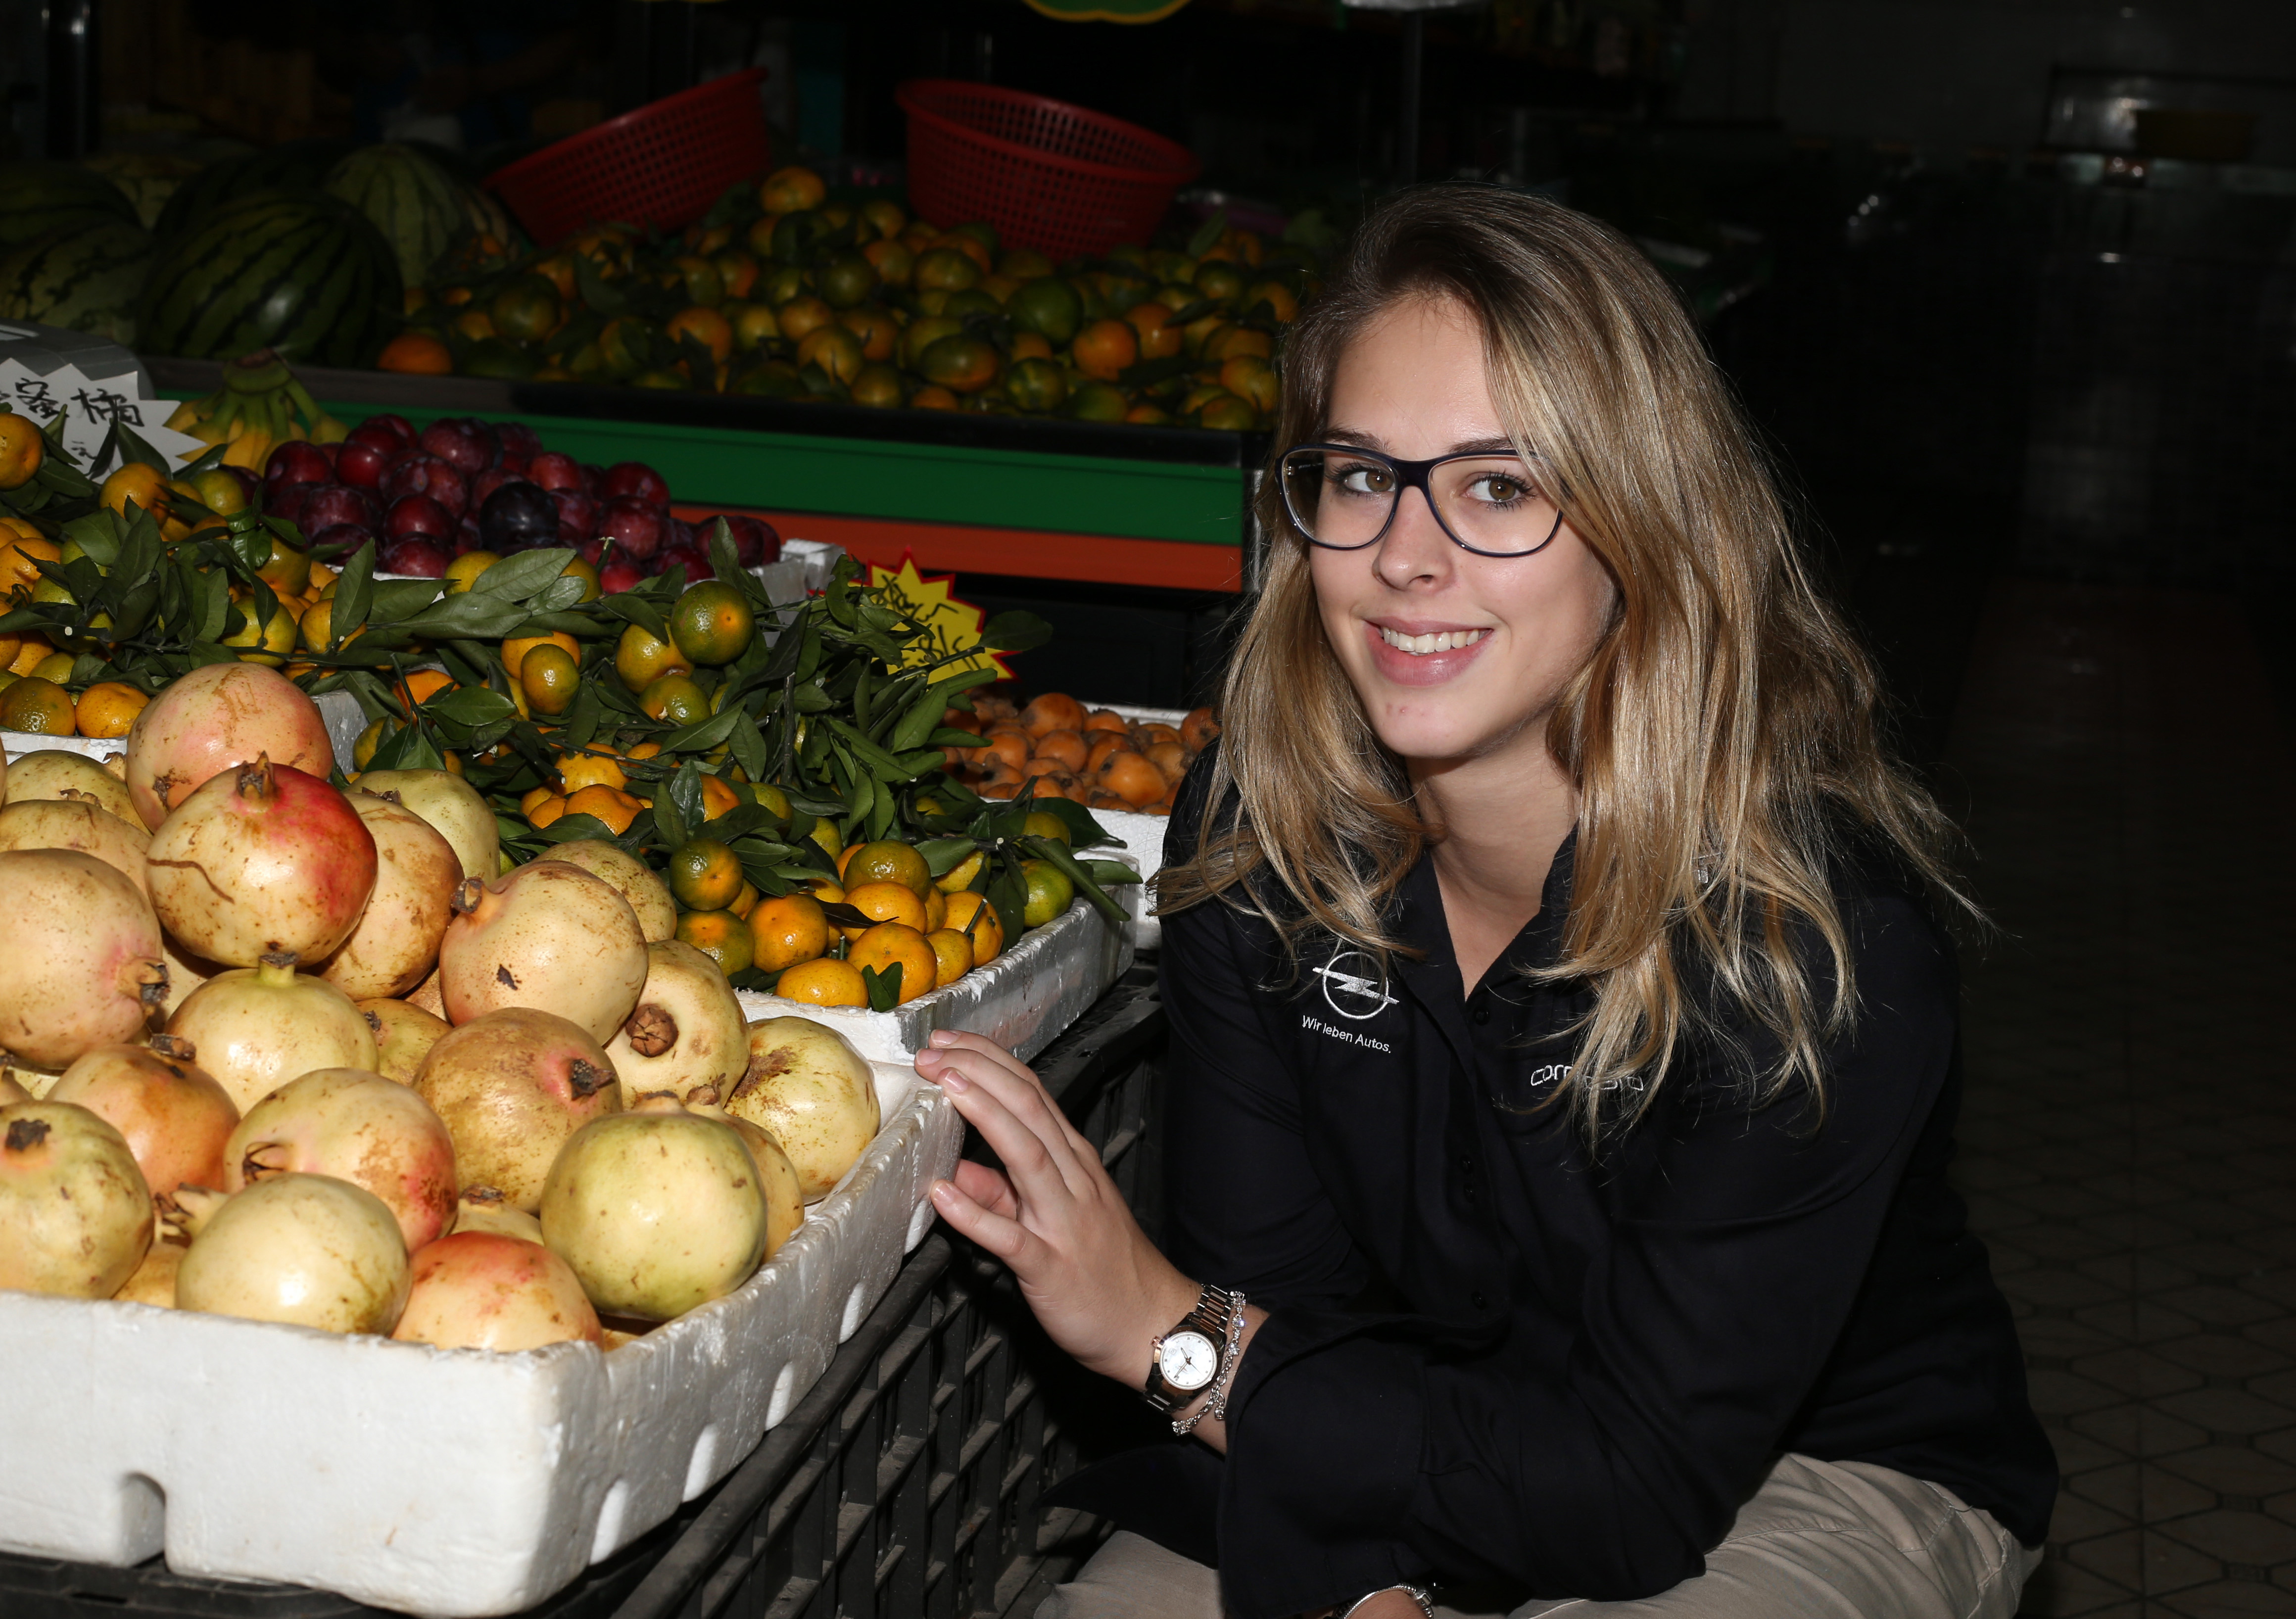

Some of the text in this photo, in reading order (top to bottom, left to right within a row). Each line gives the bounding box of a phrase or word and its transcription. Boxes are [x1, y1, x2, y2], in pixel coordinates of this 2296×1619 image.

[1302, 1015, 1391, 1053] Wir leben Autos.
